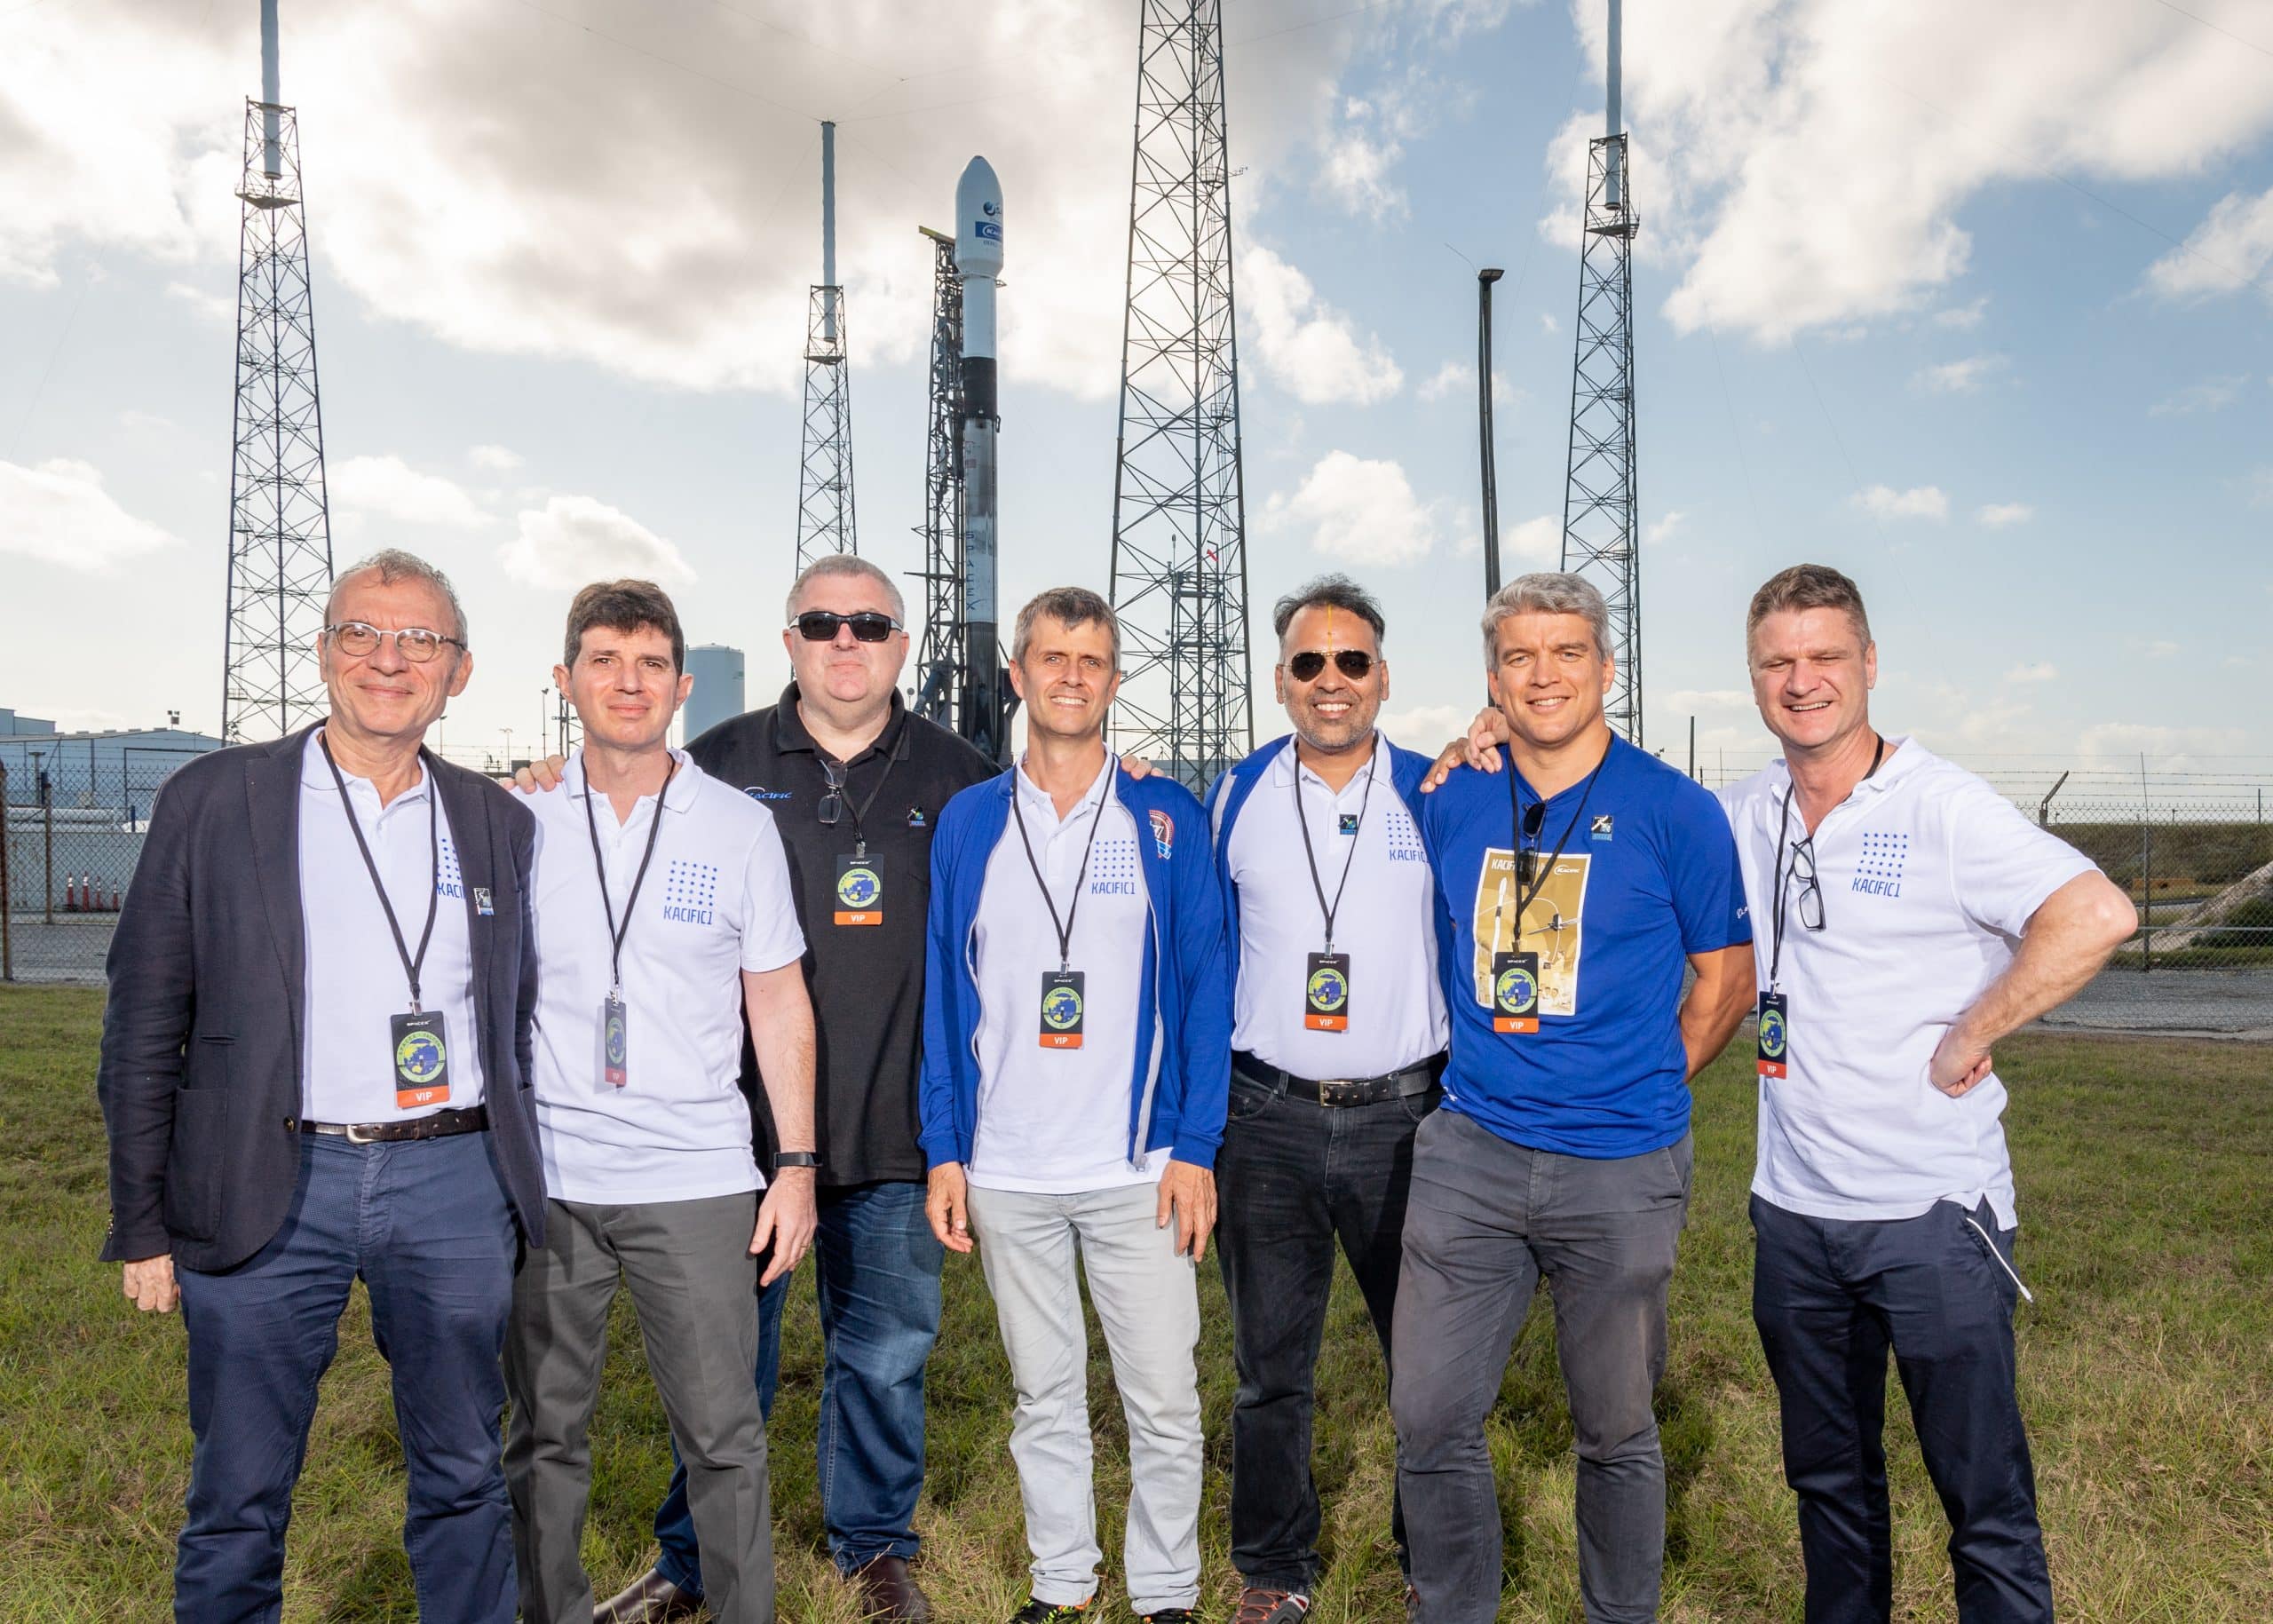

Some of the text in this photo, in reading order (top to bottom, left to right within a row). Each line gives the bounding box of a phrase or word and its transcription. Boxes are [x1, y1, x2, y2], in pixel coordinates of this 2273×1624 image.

[1390, 849, 1427, 862] KACIFIC
[437, 883, 463, 899] KACI
[1091, 882, 1136, 895] KACIFIC1
[1852, 877, 1900, 898] KACIFIC1
[663, 905, 712, 925] KACIFIC1
[851, 914, 866, 923] VIP
[1509, 1021, 1525, 1030] VIP
[1054, 1036, 1068, 1045] VIP
[1767, 1065, 1777, 1073] VIP
[416, 1091, 432, 1102] VIP
